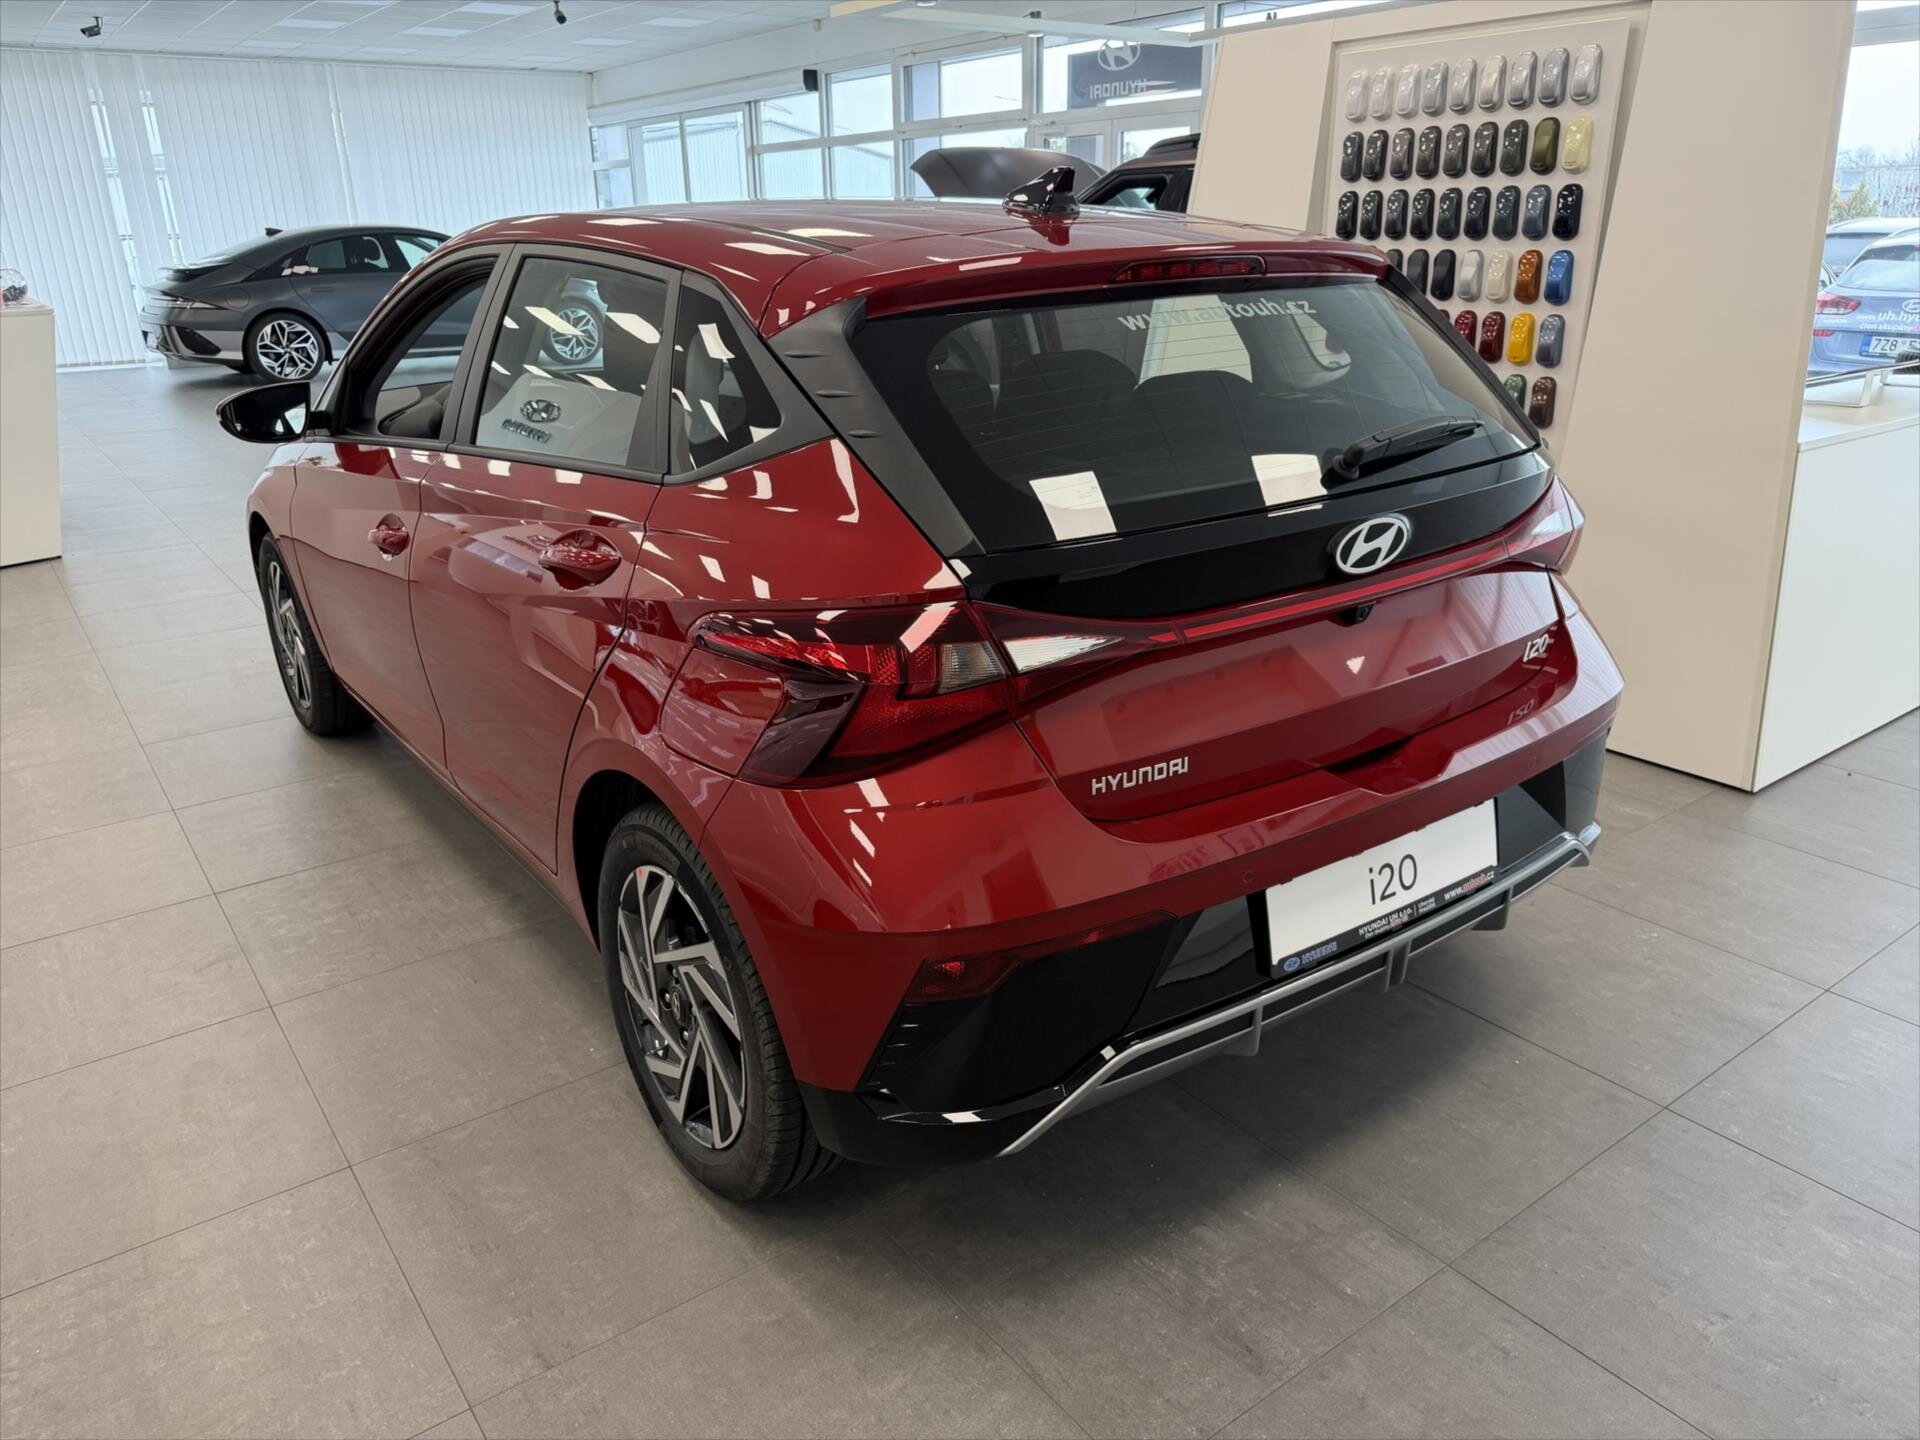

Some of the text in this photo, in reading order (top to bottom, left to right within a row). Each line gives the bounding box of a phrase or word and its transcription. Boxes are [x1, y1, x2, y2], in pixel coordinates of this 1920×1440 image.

[1091, 756, 1189, 796] HYUNDAI
[1368, 853, 1418, 905] i20
[1358, 916, 1388, 936] HYUNDAI
